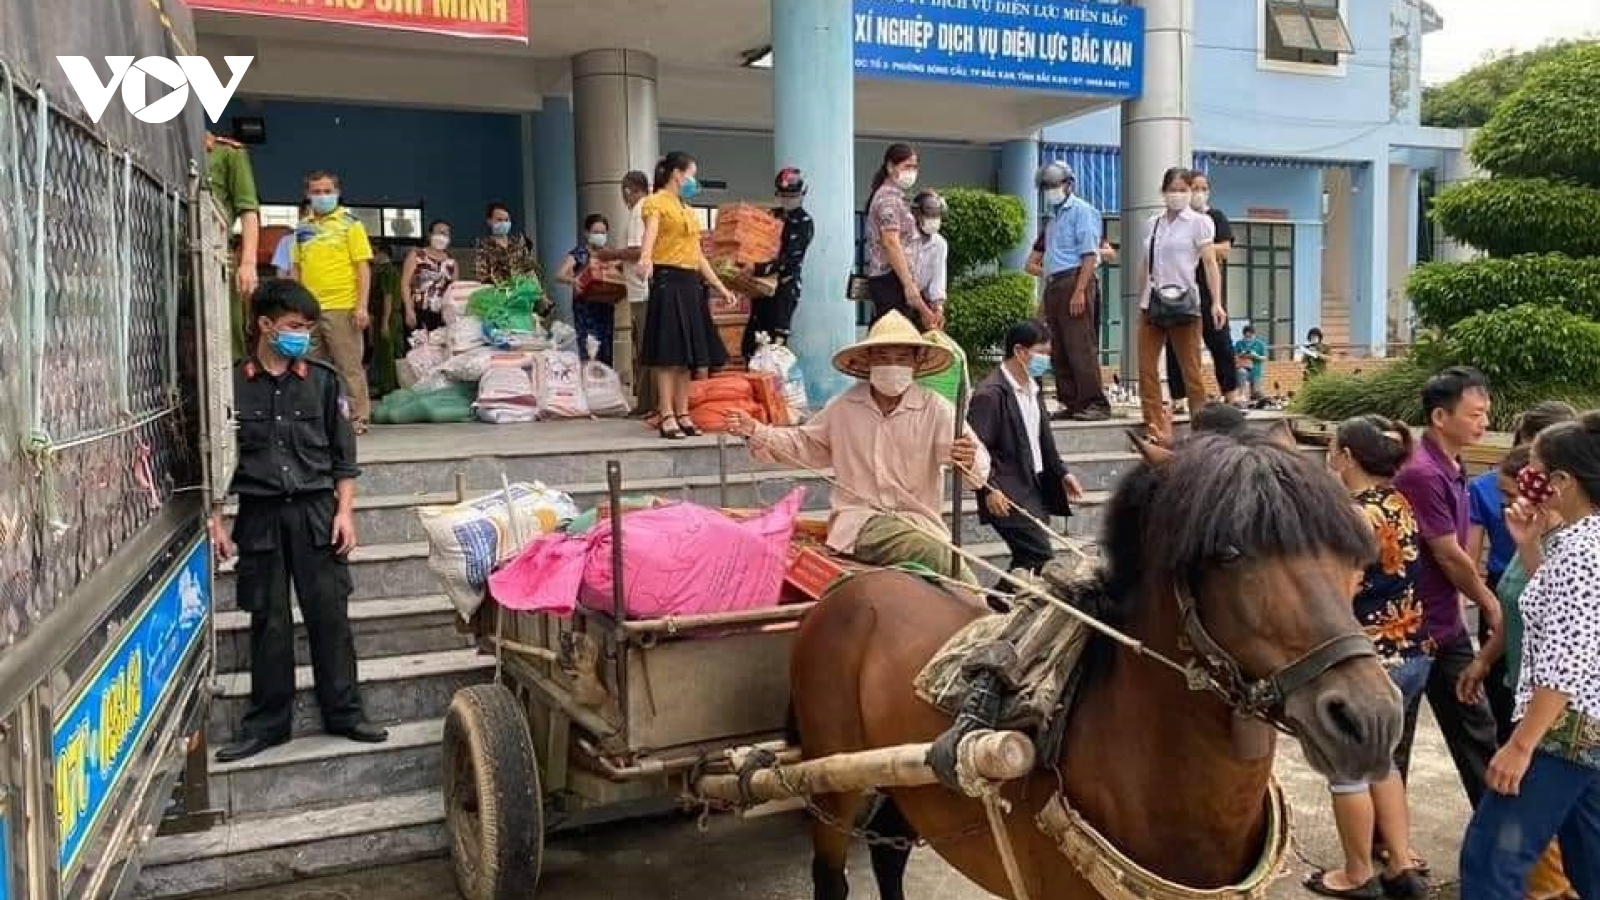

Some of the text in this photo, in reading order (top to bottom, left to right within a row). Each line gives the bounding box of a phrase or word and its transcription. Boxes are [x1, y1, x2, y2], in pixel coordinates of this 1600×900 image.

[1101, 8, 1129, 27] BẮC
[854, 9, 1133, 71] XÍ NGHIỆP DỊCH VỤ ĐIỆN LỰC BẮC KẠN
